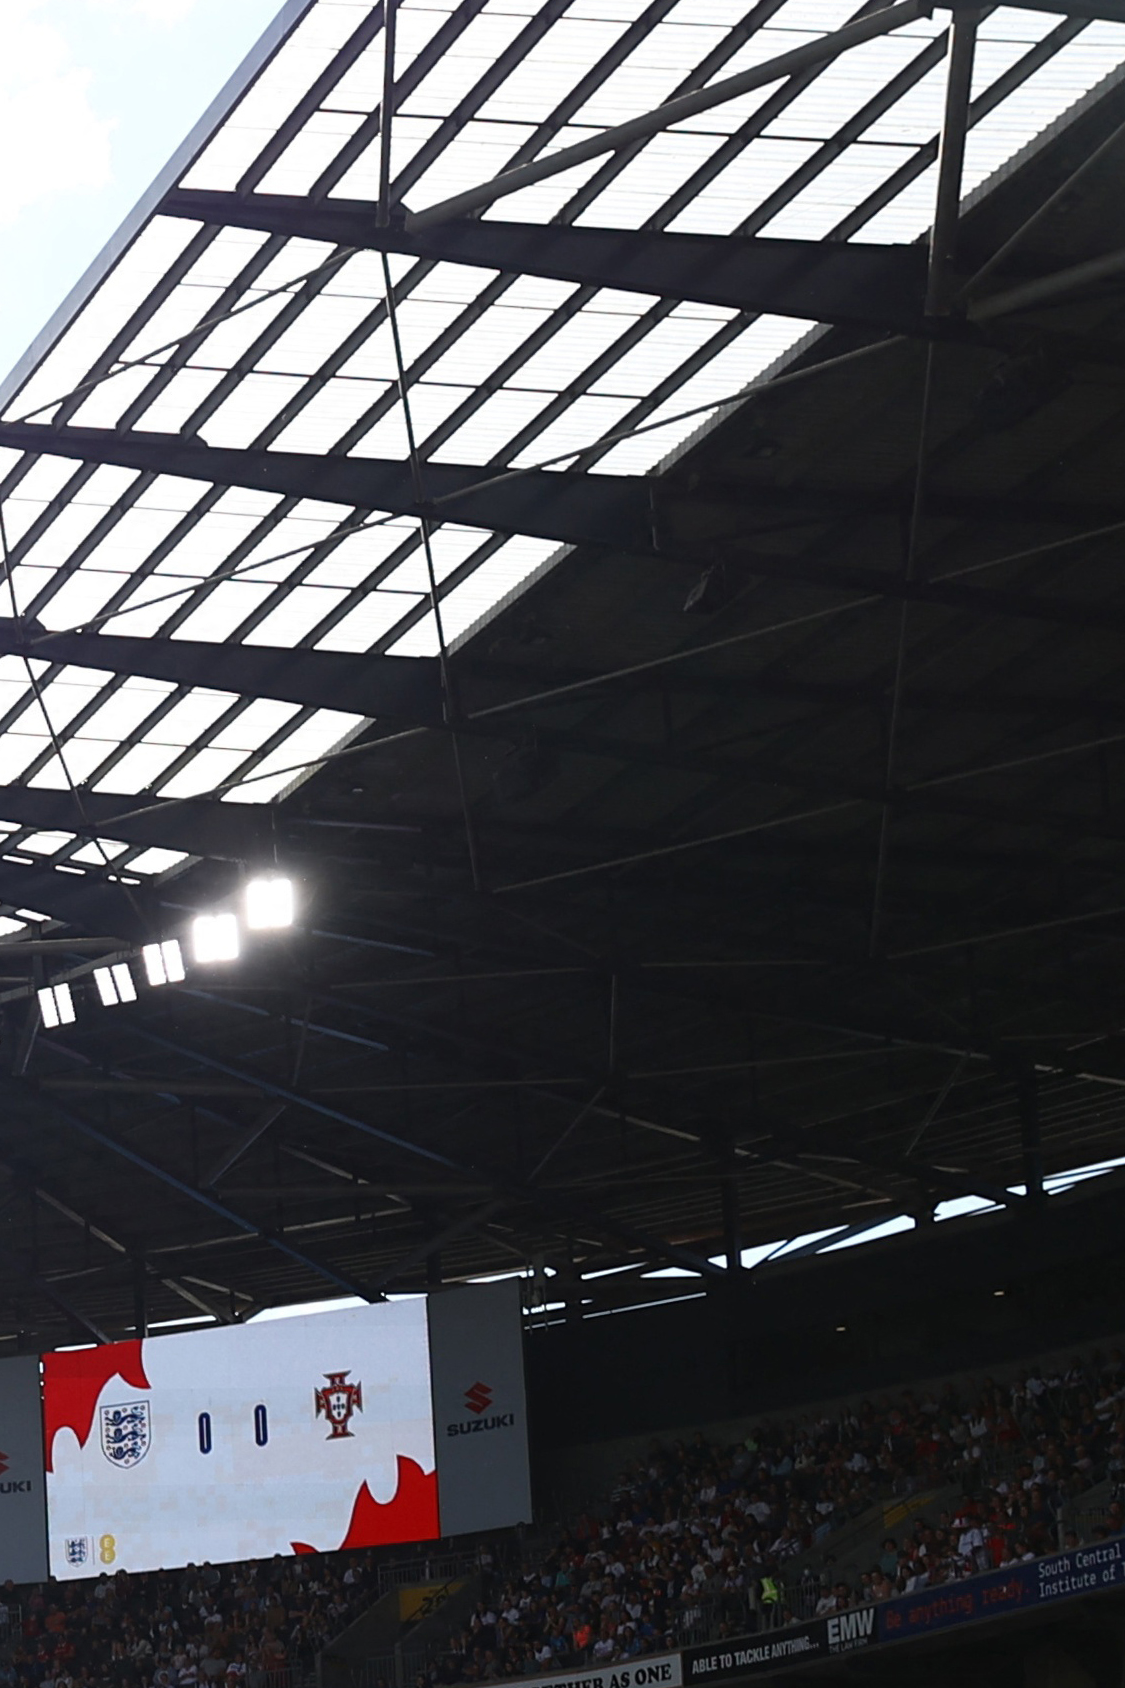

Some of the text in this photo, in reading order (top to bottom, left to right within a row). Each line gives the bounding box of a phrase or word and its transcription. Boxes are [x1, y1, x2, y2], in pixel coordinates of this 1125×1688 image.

[198, 1404, 268, 1455] 0 0
[447, 1413, 514, 1437] SUZUKI
[1038, 1542, 1122, 1579] South Central
[1038, 1573, 1096, 1598] Institute
[1102, 1563, 1116, 1582] of
[826, 1607, 875, 1645] EMW
[886, 1610, 902, 1630] Be
[908, 1593, 973, 1625] anything
[635, 1664, 672, 1685] ONE
[692, 1658, 718, 1676] ABLE
[719, 1655, 733, 1669] TO
[735, 1645, 770, 1667] TACKLE
